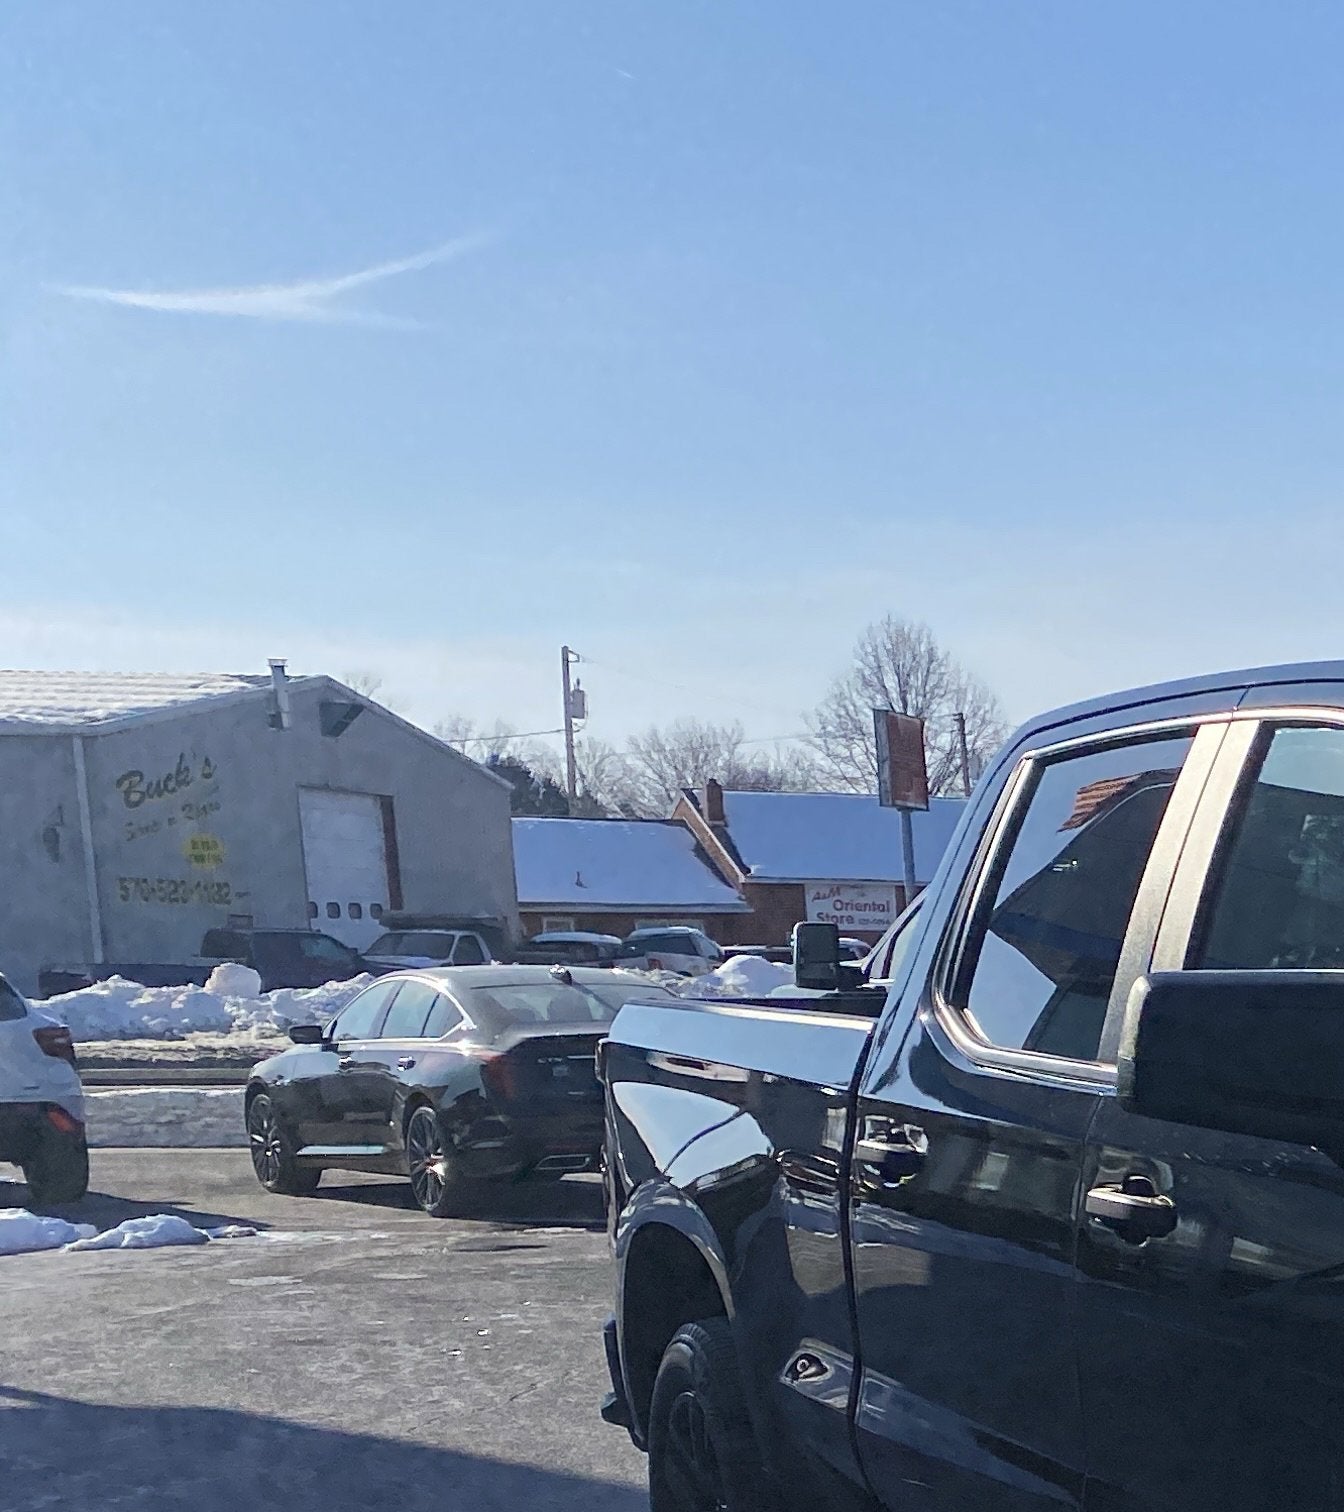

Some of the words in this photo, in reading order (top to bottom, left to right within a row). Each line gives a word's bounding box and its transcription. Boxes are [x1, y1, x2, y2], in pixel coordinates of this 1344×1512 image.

[116, 752, 218, 809] Buck's
[832, 899, 890, 912] Oriental
[816, 912, 854, 925] Store
